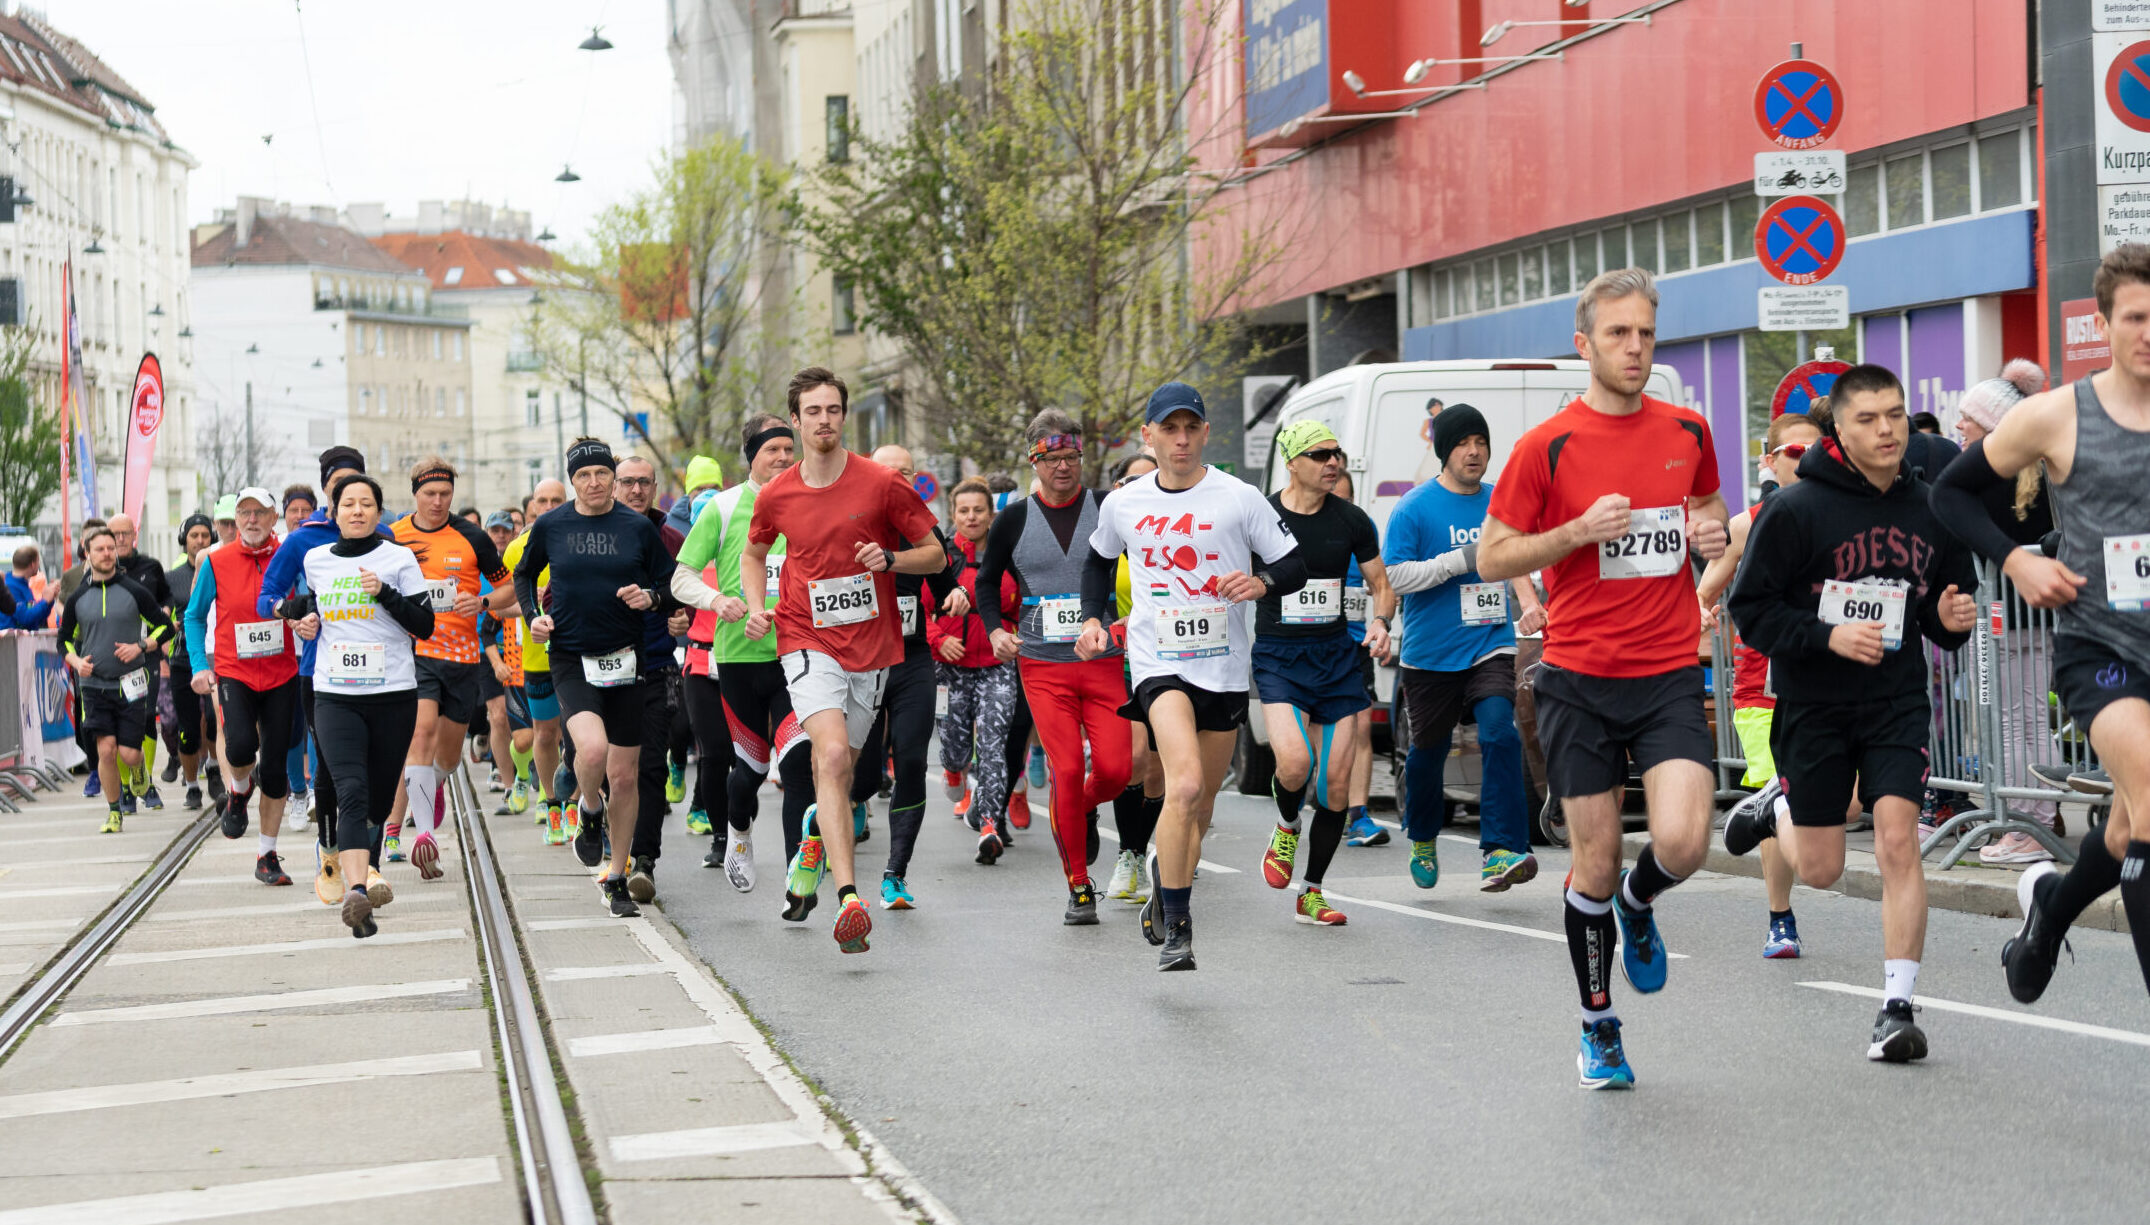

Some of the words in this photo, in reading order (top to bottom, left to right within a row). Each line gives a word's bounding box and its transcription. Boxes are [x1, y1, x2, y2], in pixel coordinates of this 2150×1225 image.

[1775, 132, 1826, 149] ANFANG
[1759, 175, 1774, 187] für
[1784, 272, 1819, 285] ENDE
[567, 532, 619, 545] READY
[1604, 528, 1682, 558] 52789
[765, 565, 780, 579] 61
[2134, 555, 2150, 578] 6
[319, 592, 343, 606] MIT
[430, 587, 445, 600] 10
[814, 587, 873, 613] 52635
[1299, 590, 1328, 606] 616
[1477, 593, 1500, 608] 642
[1343, 597, 1367, 612] 2515
[1843, 599, 1884, 621] 690
[324, 605, 376, 622] MAHÜ!
[1057, 609, 1083, 624] 632
[1174, 618, 1209, 637] 619
[249, 630, 272, 643] 645
[342, 653, 367, 667] 681
[597, 658, 622, 671] 653
